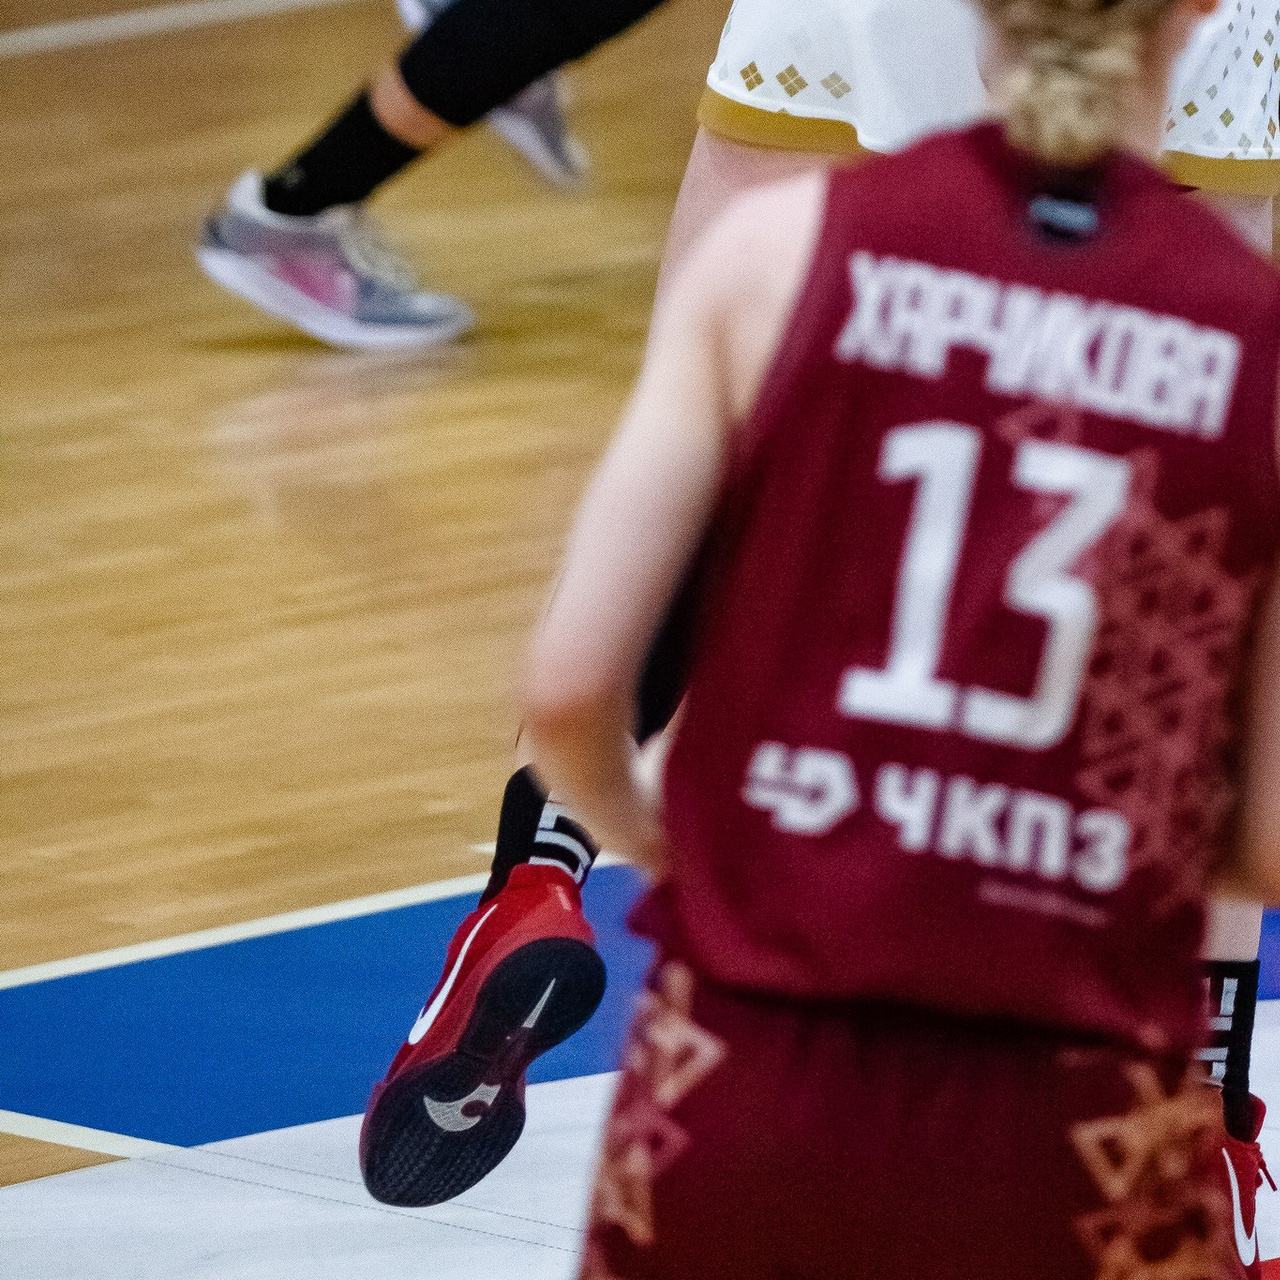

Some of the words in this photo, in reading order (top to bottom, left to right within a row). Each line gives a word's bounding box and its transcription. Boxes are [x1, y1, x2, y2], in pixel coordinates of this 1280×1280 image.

[835, 251, 1241, 438] ХАРЧИКОВА
[839, 422, 1131, 746] 13
[874, 763, 1131, 891] ЧКПЗ
